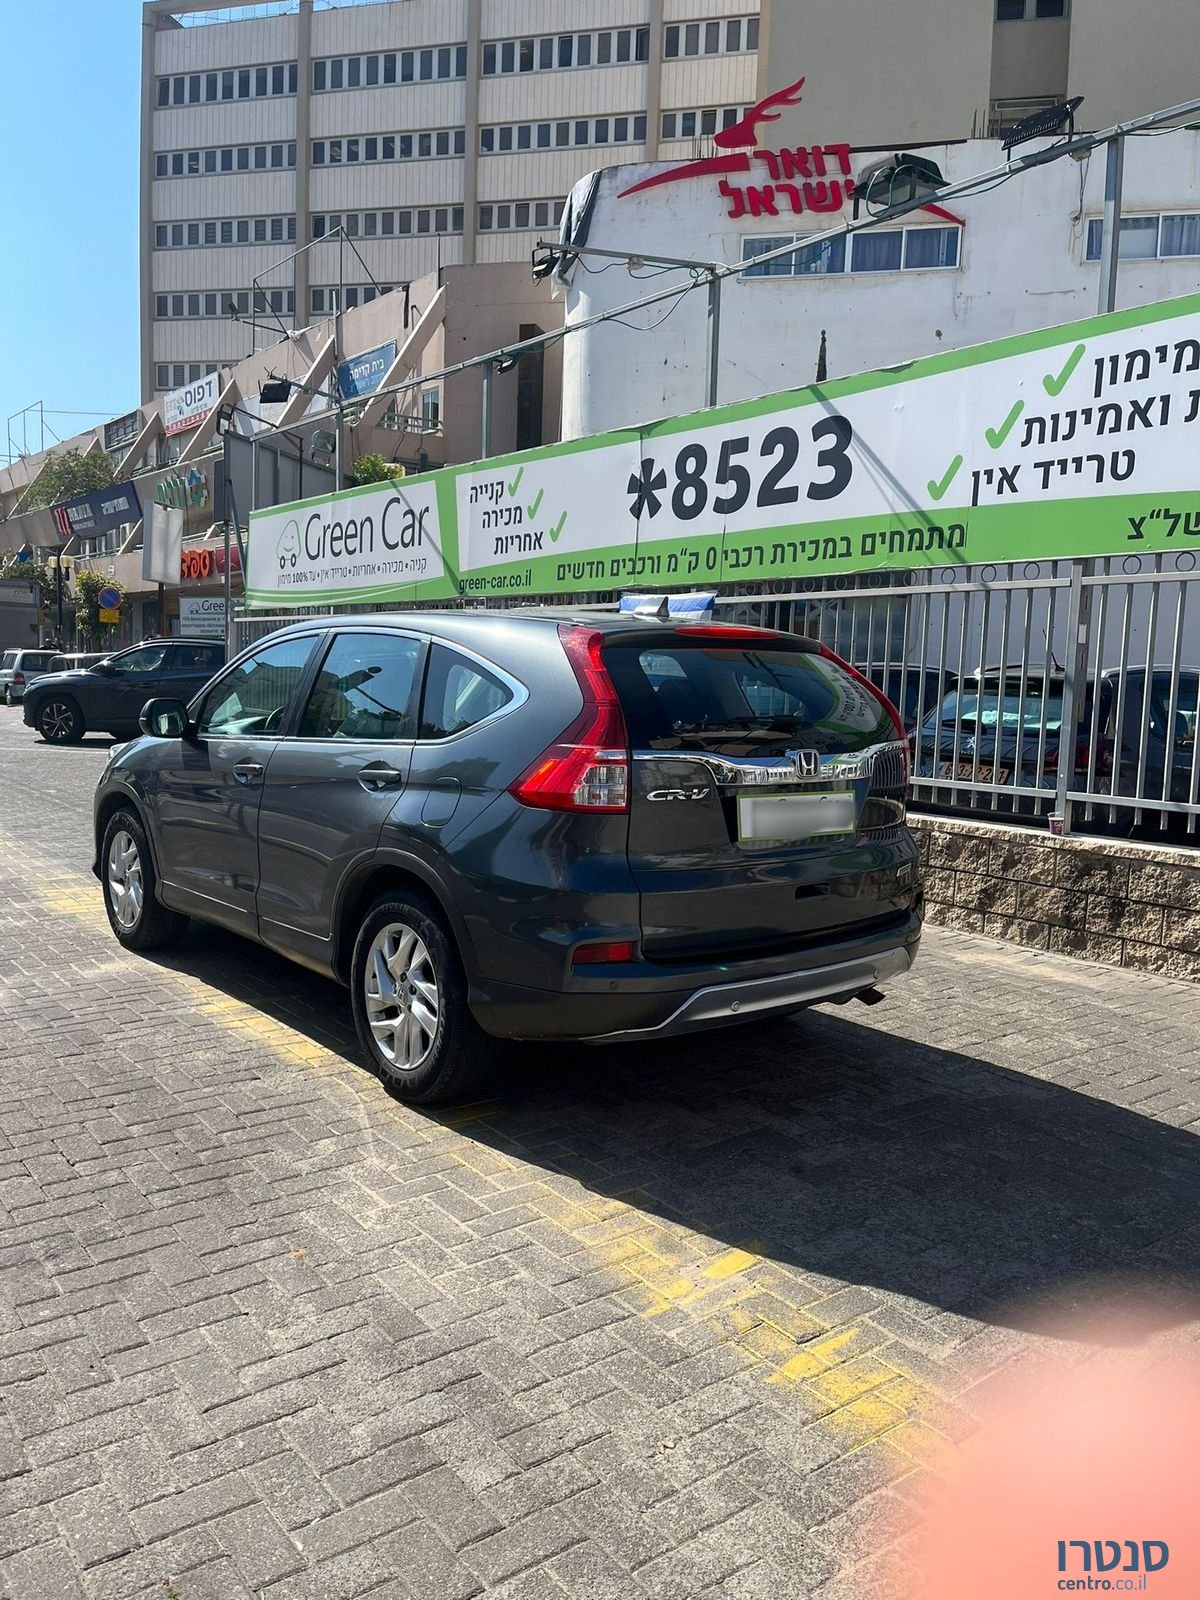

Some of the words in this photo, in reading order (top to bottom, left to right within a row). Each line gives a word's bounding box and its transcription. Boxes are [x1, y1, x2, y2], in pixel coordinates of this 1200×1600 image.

[753, 143, 851, 180] דואר
[719, 177, 855, 219] ישראל
[1094, 338, 1200, 398] מימון
[185, 380, 213, 408] דפוס
[1020, 394, 1172, 448] ואמינות
[1033, 449, 1136, 490] טרייד
[470, 481, 505, 505] קנייה
[971, 464, 1021, 507] אין
[304, 512, 373, 562] Green
[381, 496, 430, 551] Car
[482, 506, 523, 530] מכירה
[493, 531, 544, 556] אחריות
[769, 535, 852, 566] במכירת
[860, 524, 966, 556] מתמחים
[381, 561, 404, 575] מכירה
[609, 553, 661, 575] ורכבים
[705, 546, 715, 571] 0
[721, 545, 764, 568] רכבי
[292, 572, 308, 583] 100%
[352, 563, 377, 577] אחריות
[458, 569, 532, 595] green-car.co.il
[556, 561, 606, 582] חדשים
[201, 599, 225, 611] Gree
[646, 788, 710, 802] CR-V
